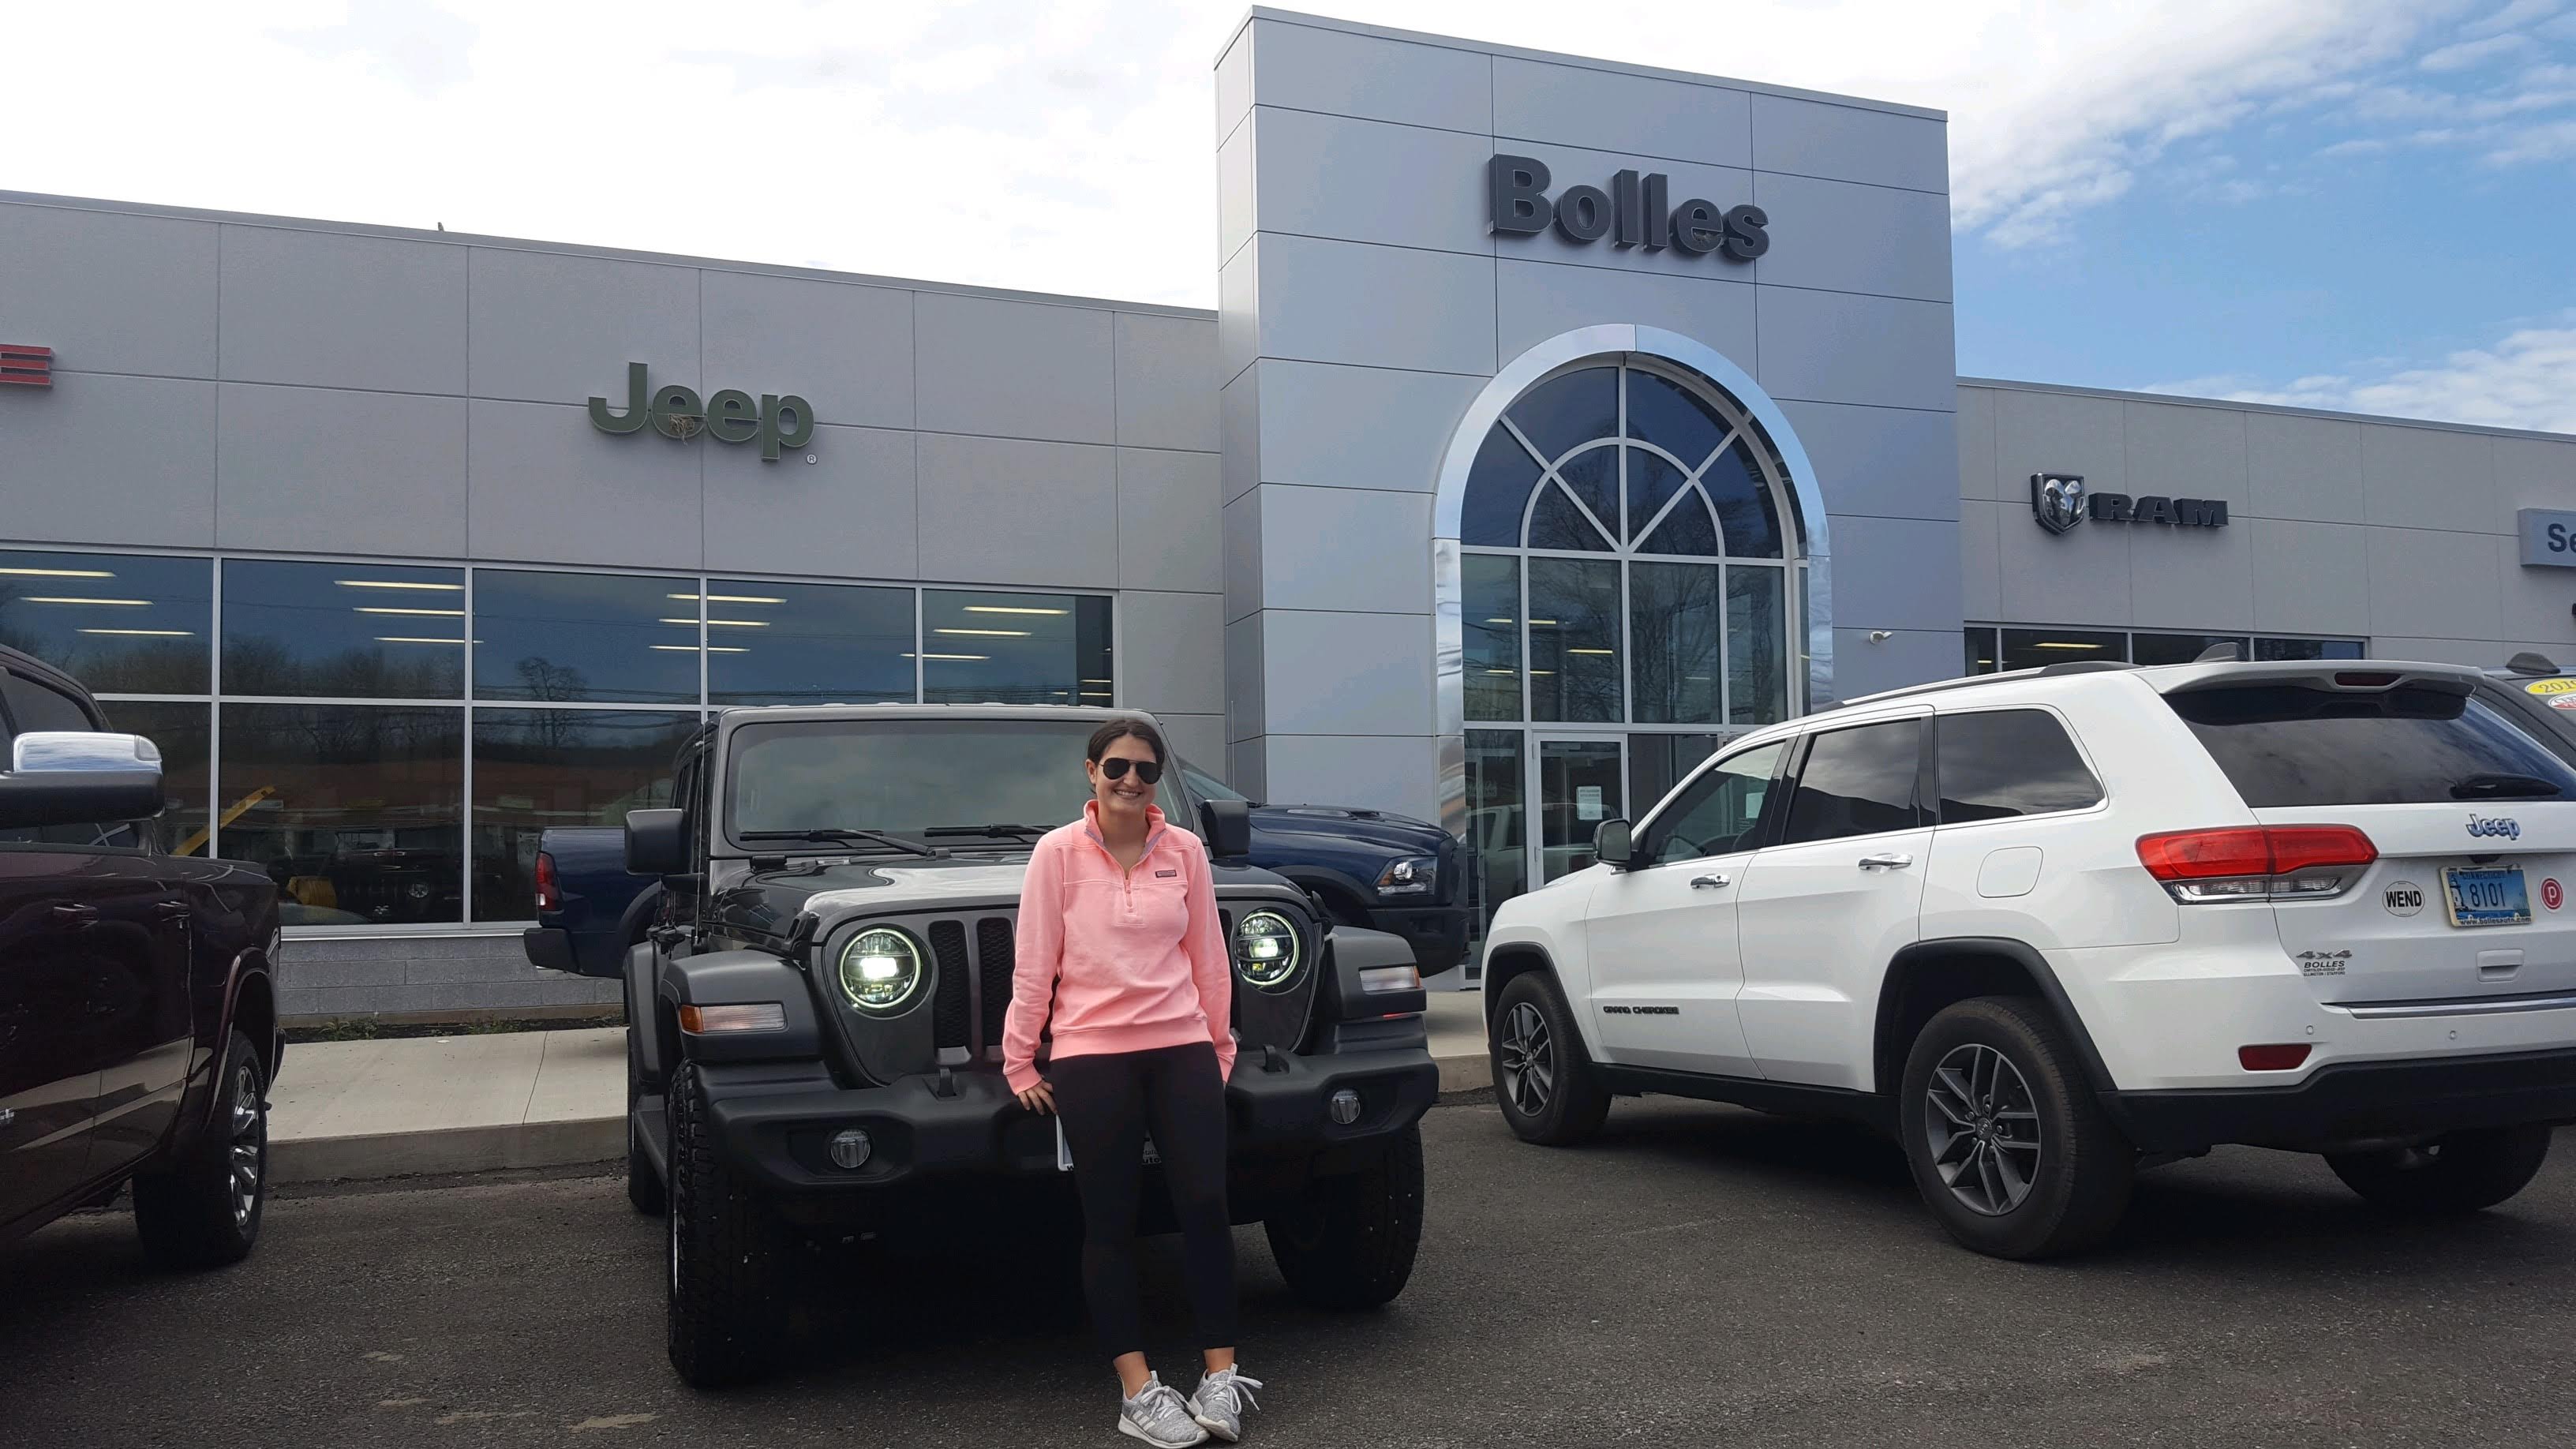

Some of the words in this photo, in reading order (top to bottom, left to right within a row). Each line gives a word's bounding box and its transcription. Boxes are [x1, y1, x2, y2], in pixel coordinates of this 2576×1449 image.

[1488, 154, 1769, 259] Bolles
[588, 361, 814, 461] Jeep
[2088, 492, 2229, 526] RAM
[2466, 814, 2521, 841] Jeep
[2386, 890, 2422, 908] WEND
[2469, 882, 2506, 907] 8101
[1632, 1006, 1679, 1015] CHEROKEE
